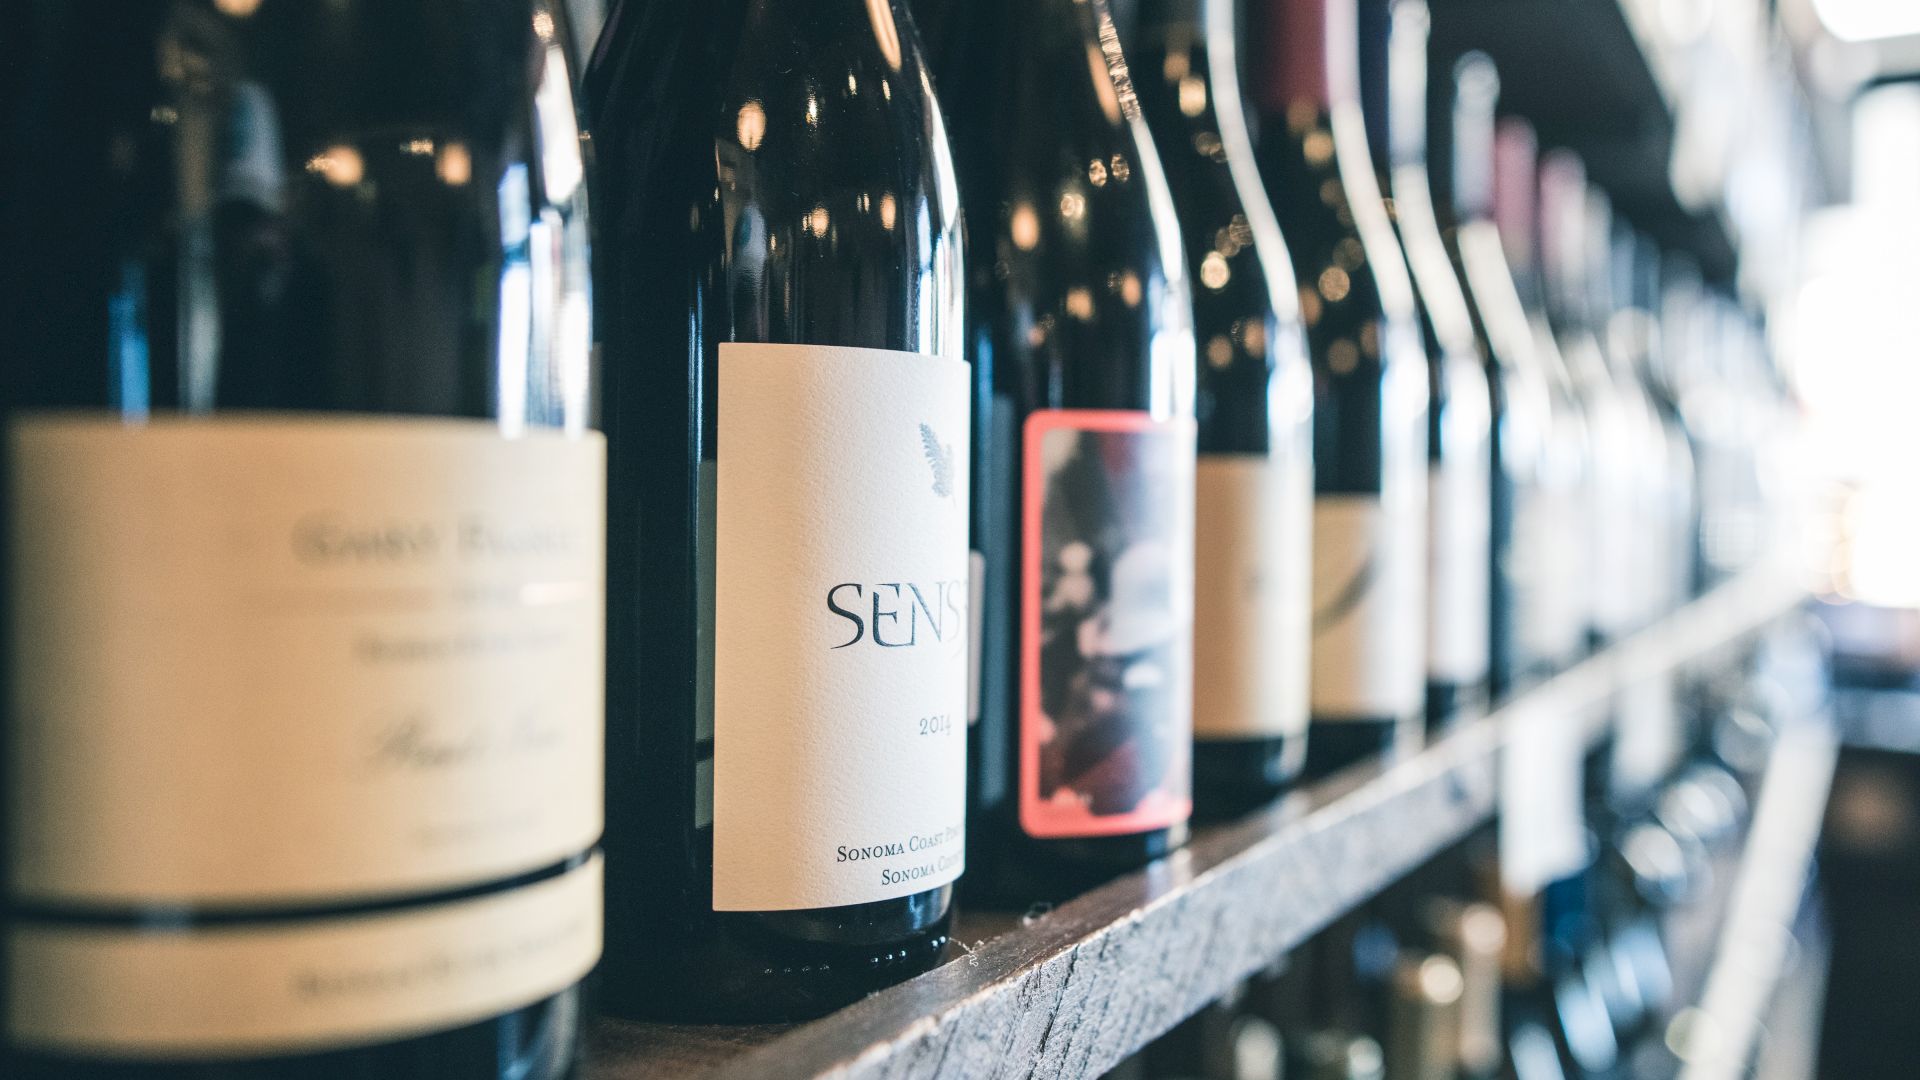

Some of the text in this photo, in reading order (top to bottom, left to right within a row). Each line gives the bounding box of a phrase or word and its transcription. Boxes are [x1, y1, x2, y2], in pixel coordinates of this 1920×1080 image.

[826, 579, 967, 656] SENS
[919, 713, 952, 736] 2014
[837, 843, 905, 862] SONOMA
[909, 832, 944, 852] COAST
[881, 864, 936, 886] SONOMA
